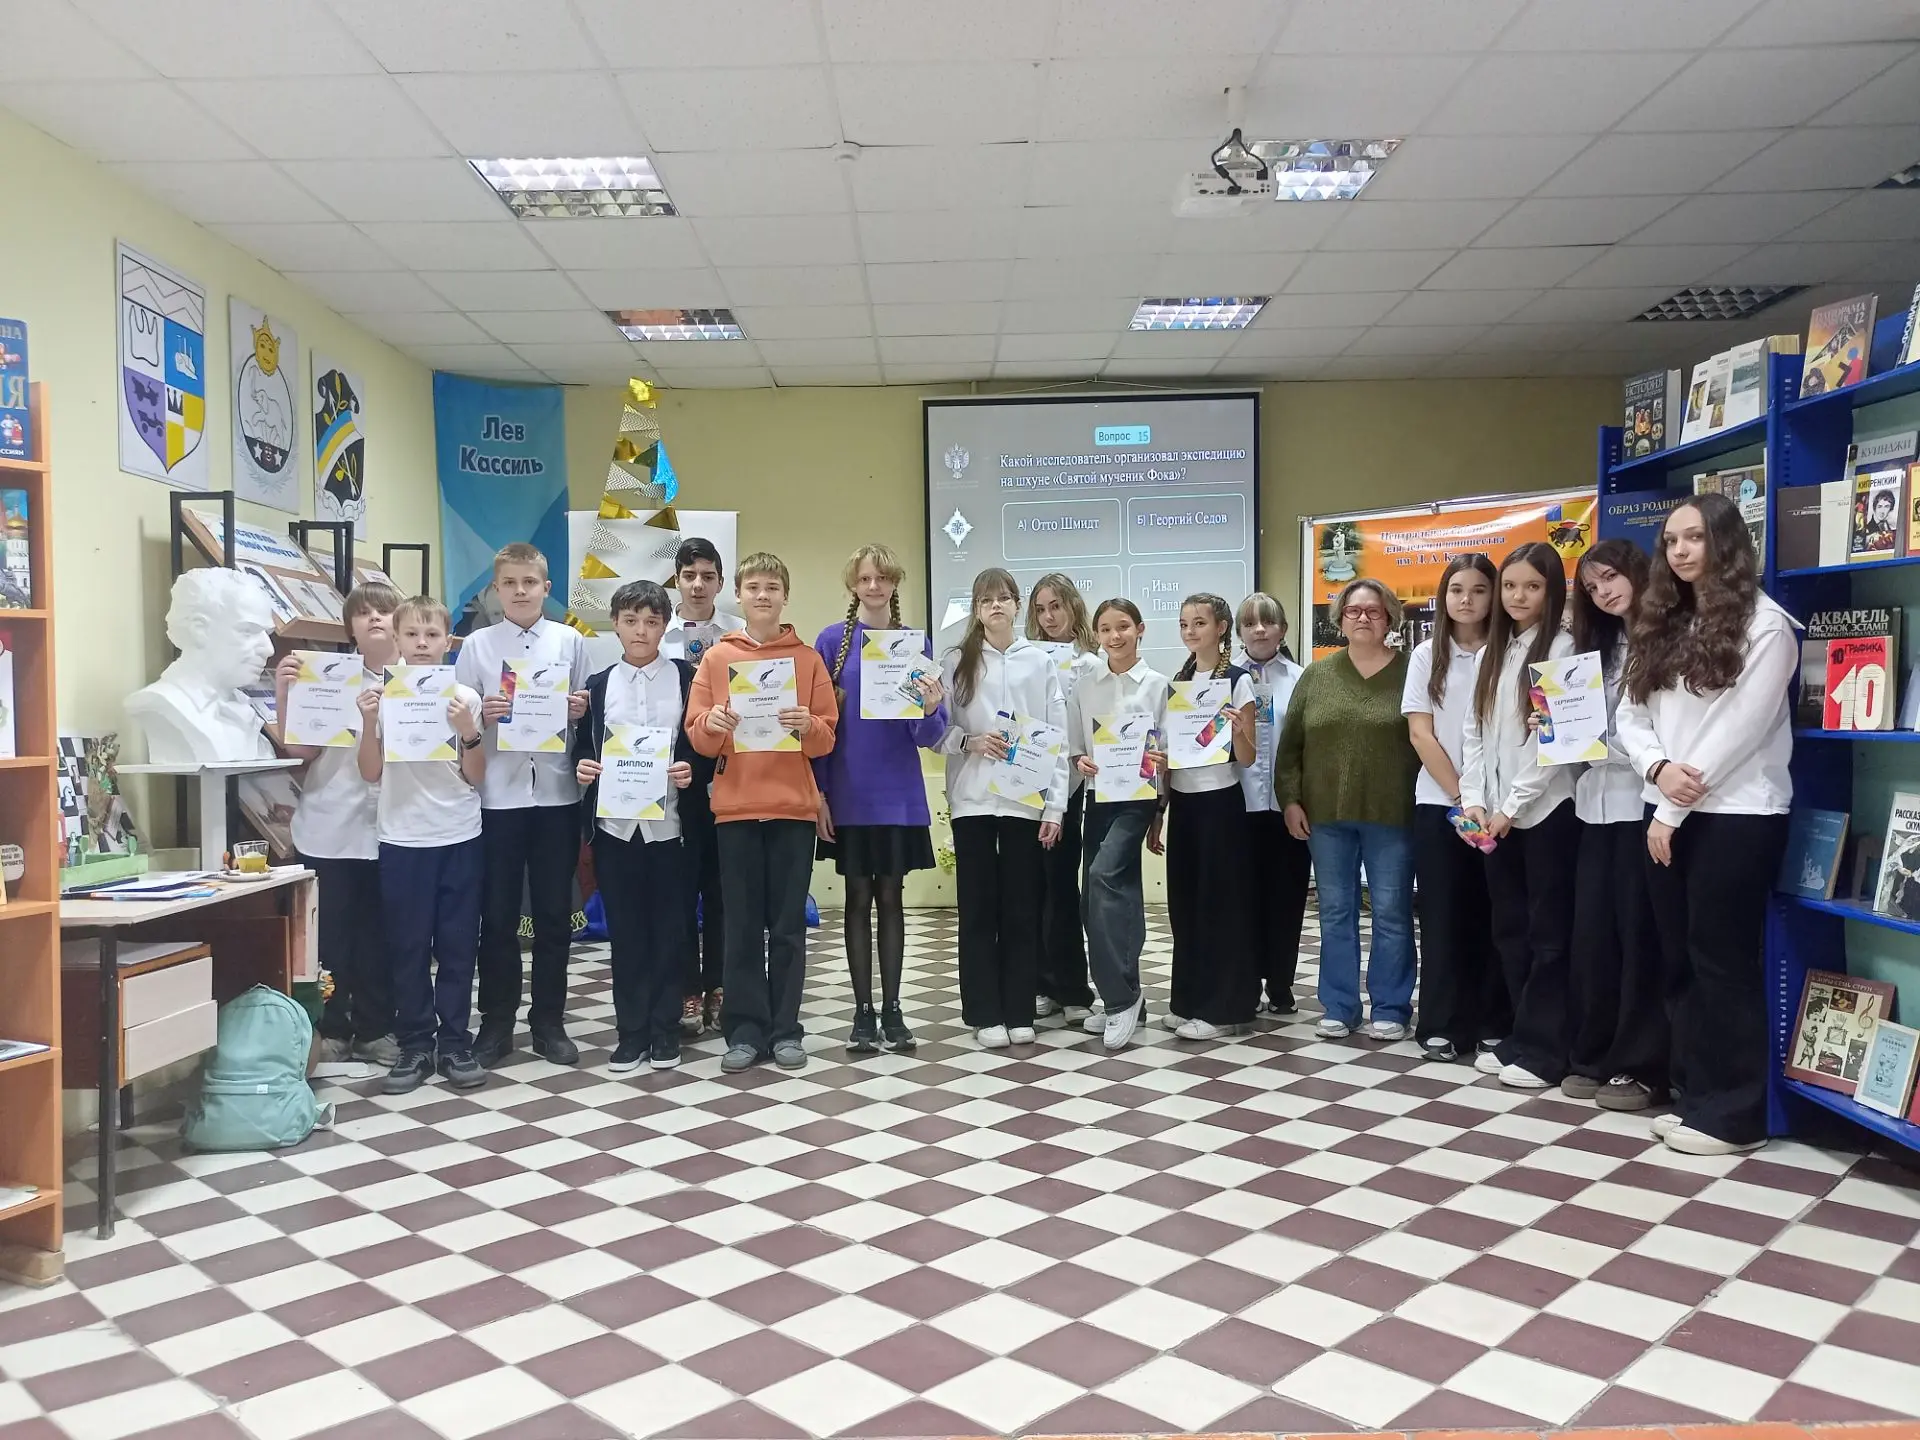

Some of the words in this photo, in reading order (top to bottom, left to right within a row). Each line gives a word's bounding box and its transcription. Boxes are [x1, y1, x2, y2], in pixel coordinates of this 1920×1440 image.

[1854, 311, 1864, 325] 12
[0, 325, 23, 340] НА
[482, 415, 525, 441] Лев
[1098, 431, 1131, 443] Вопрос
[1138, 430, 1149, 442] 15
[1861, 440, 1912, 458] КУИНДЖИ
[460, 445, 544, 475] Кассиль
[1000, 453, 1033, 468] Какой
[1036, 453, 1112, 467] исследователь
[1114, 450, 1179, 466] организовал
[1181, 448, 1246, 462] экспедицию
[1000, 476, 1013, 487] на
[1016, 475, 1050, 489] шхуне
[1053, 470, 1097, 485] «Святой
[1100, 471, 1145, 486] мученик
[1147, 467, 1187, 481] Фока»?
[1858, 476, 1897, 490] КИПРЕНСКИЙ
[1608, 503, 1640, 516] ОБРАЗ
[1017, 519, 1027, 531] А)
[1031, 518, 1058, 531] Отто
[1060, 517, 1100, 530] Шмидт
[1137, 514, 1146, 526] Б)
[1149, 512, 1193, 529] Георгий
[1195, 511, 1228, 525] Седов
[1152, 579, 1180, 592] Иван
[1808, 608, 1890, 626] АКВАРЕЛЬ
[1808, 623, 1849, 634] РИСУНОК
[1851, 622, 1888, 632] ЭСТАМП
[1831, 647, 1845, 665] 10
[1845, 642, 1883, 653] ГРАФИКА
[1830, 663, 1886, 730] 10
[616, 759, 654, 768] ДИПЛОМ
